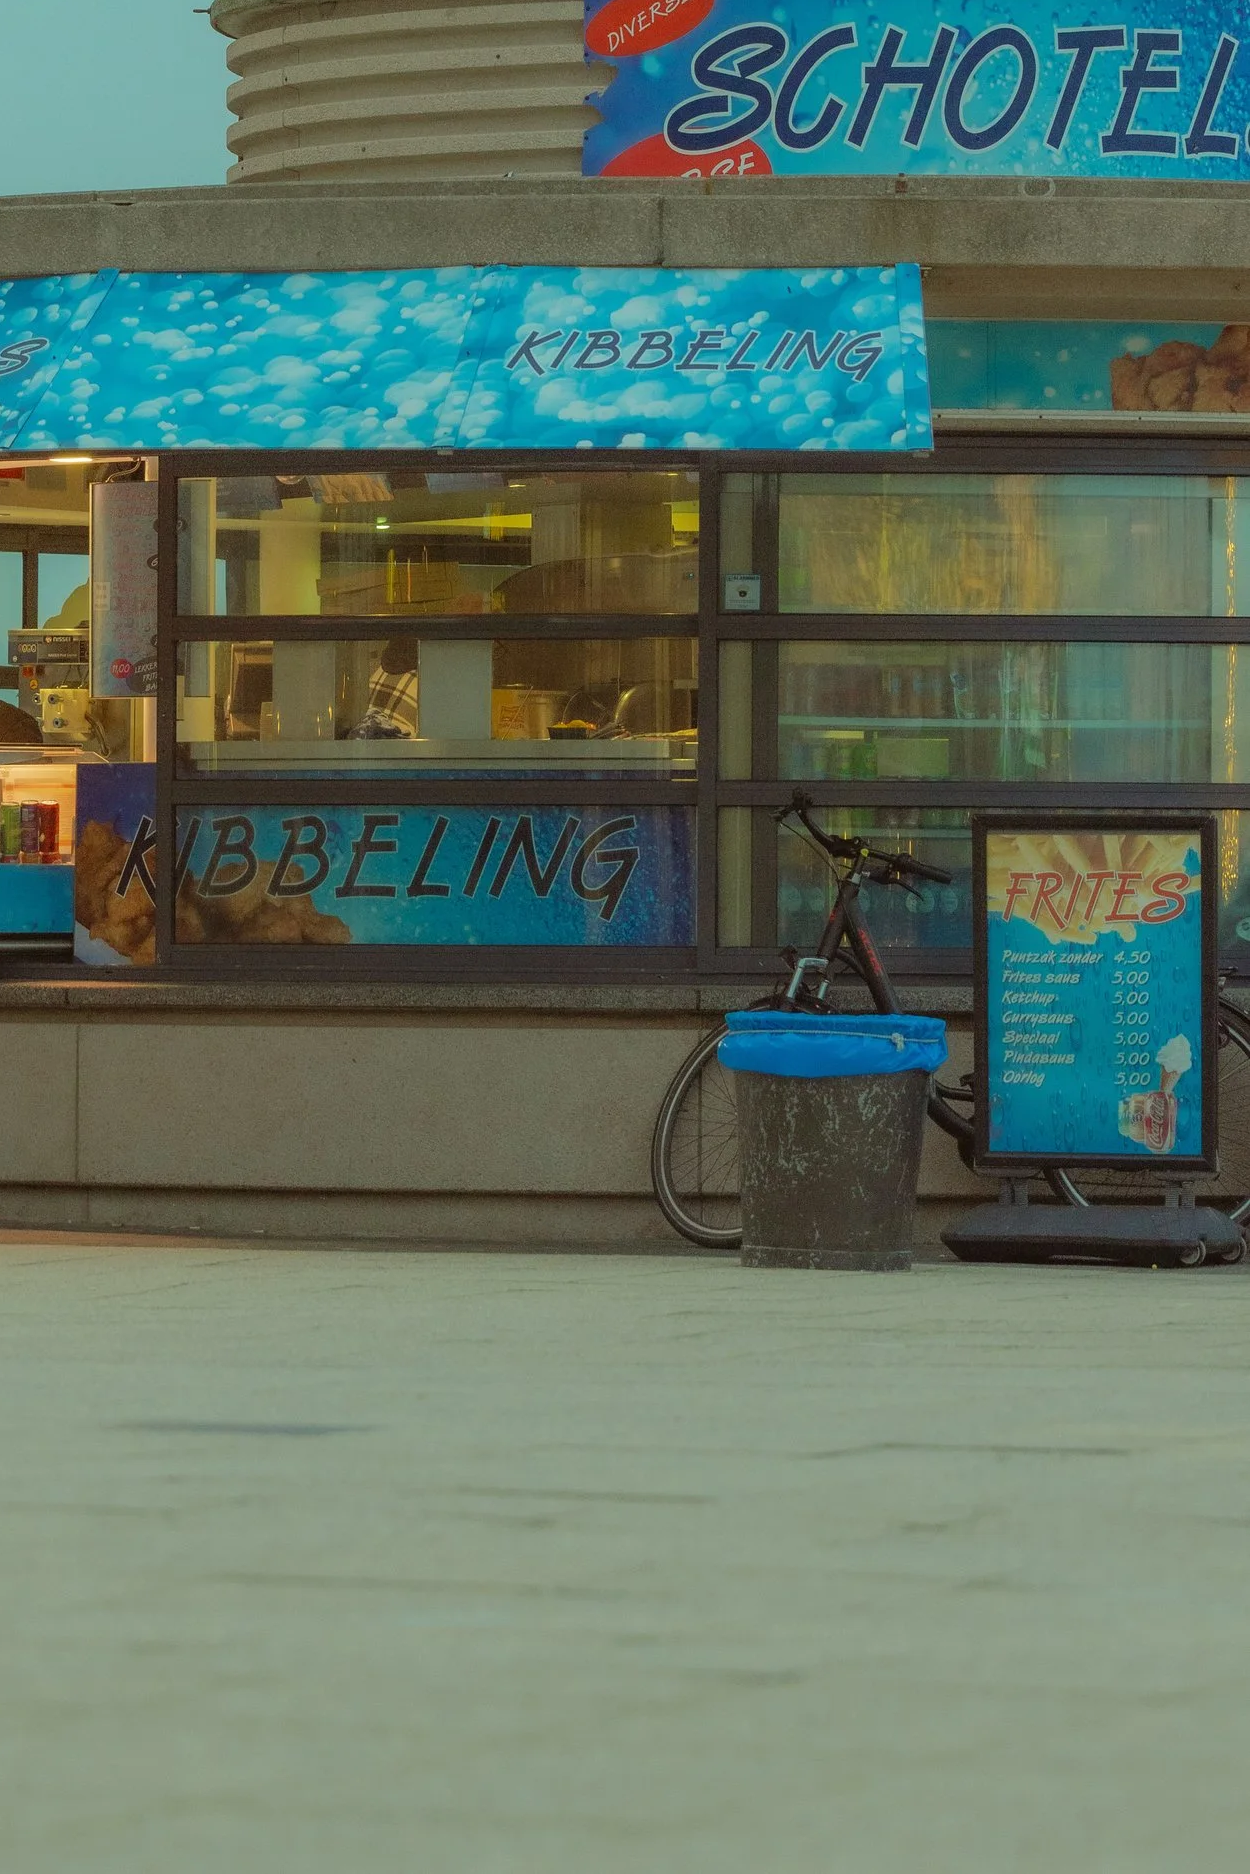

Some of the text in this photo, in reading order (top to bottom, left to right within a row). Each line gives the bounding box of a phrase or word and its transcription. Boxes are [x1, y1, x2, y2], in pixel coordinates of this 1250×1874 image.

[664, 22, 1249, 160] SCHOTEL
[505, 328, 883, 382] KIBBELING
[114, 813, 640, 921] KIBBELING
[1002, 870, 1192, 931] FRITES
[1002, 950, 1151, 965] Puntzak zonder 4,50
[1002, 970, 1149, 985] Frites saus 5,00
[1002, 990, 1149, 1006] Ketchup 5,00
[1002, 1011, 1149, 1027] Currysaus 5,00
[1002, 1030, 1150, 1046] Speciaal 5,00
[1003, 1050, 1150, 1066] Pindasaus 5,00
[1002, 1070, 1151, 1088] Oorlog 5,00
